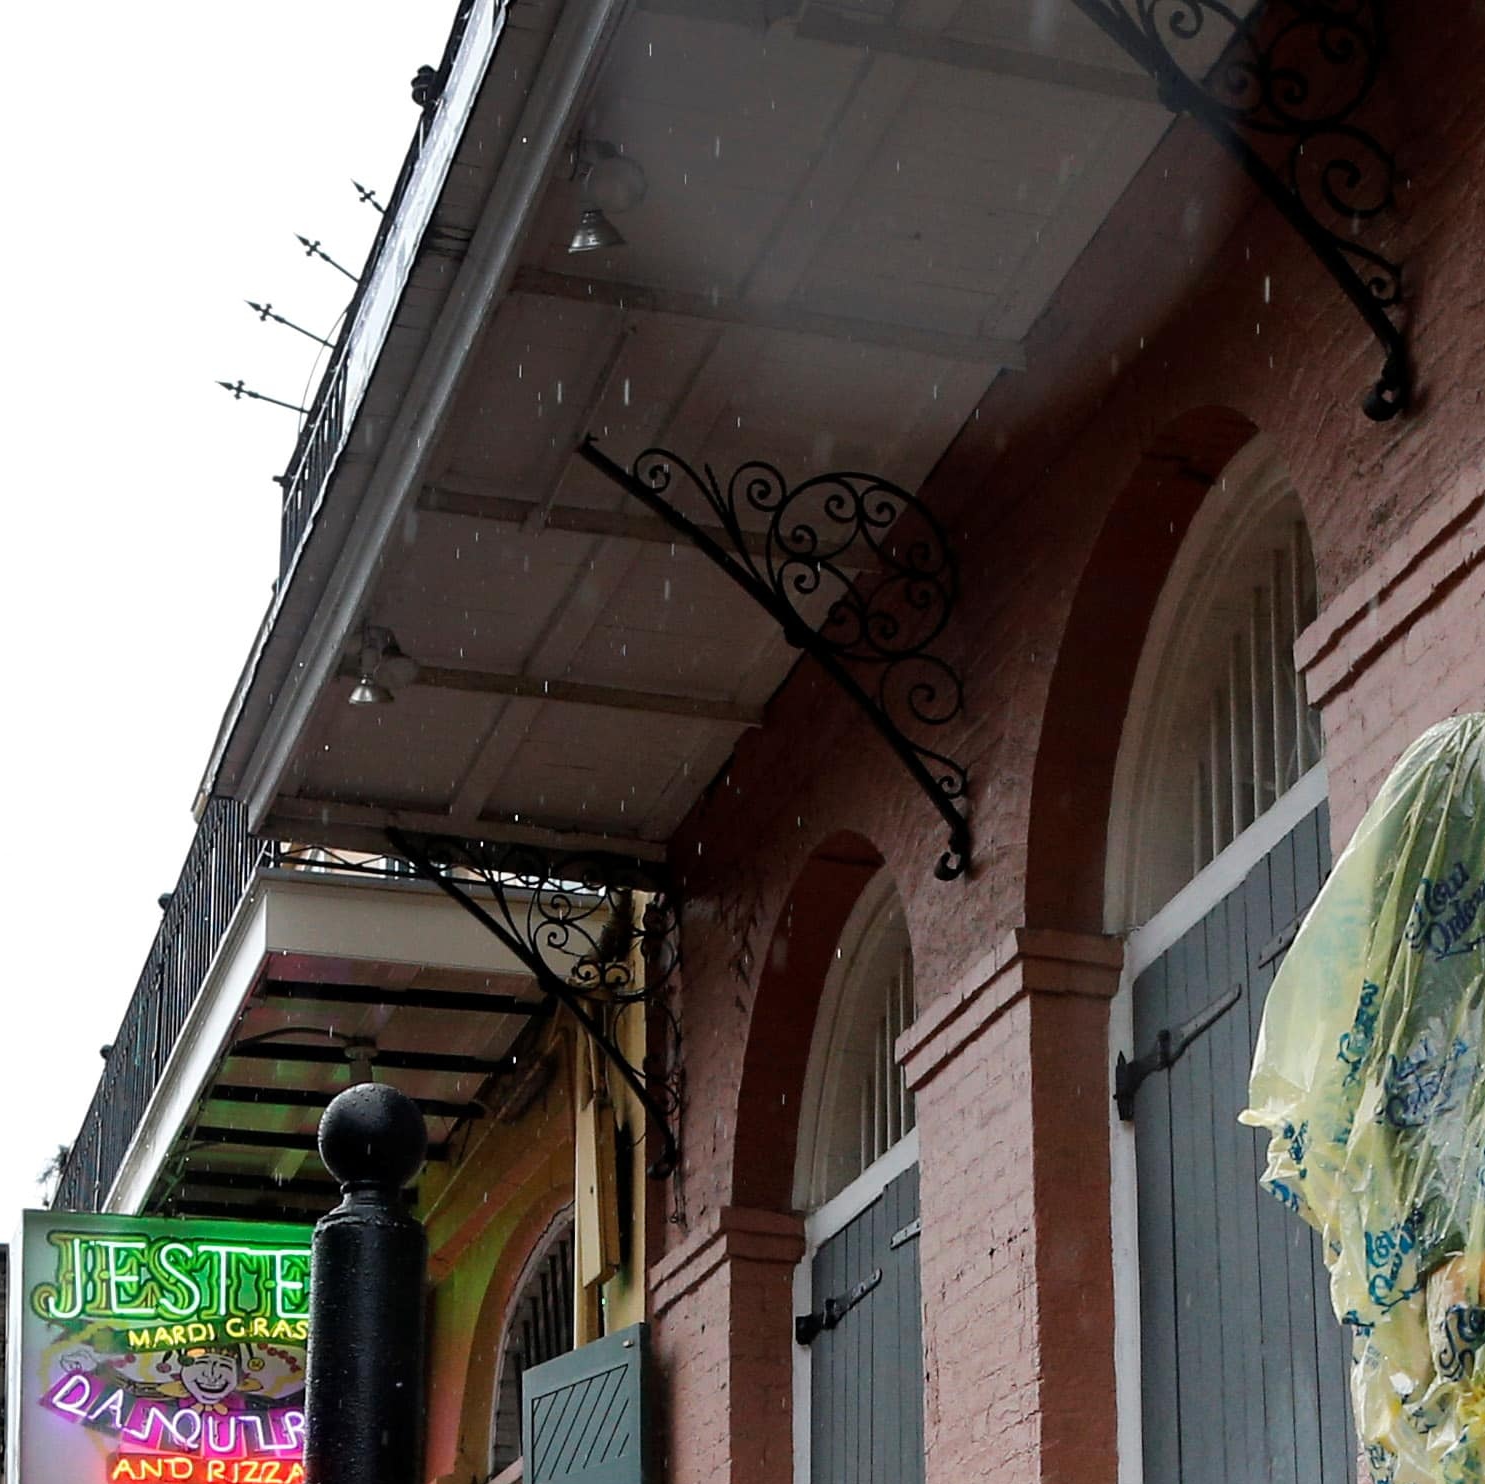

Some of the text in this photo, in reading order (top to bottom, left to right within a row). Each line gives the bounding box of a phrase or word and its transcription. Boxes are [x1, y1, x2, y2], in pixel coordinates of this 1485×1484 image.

[31, 1233, 313, 1321] JESTE
[128, 1320, 216, 1349] MARDI
[112, 1457, 194, 1482] AND
